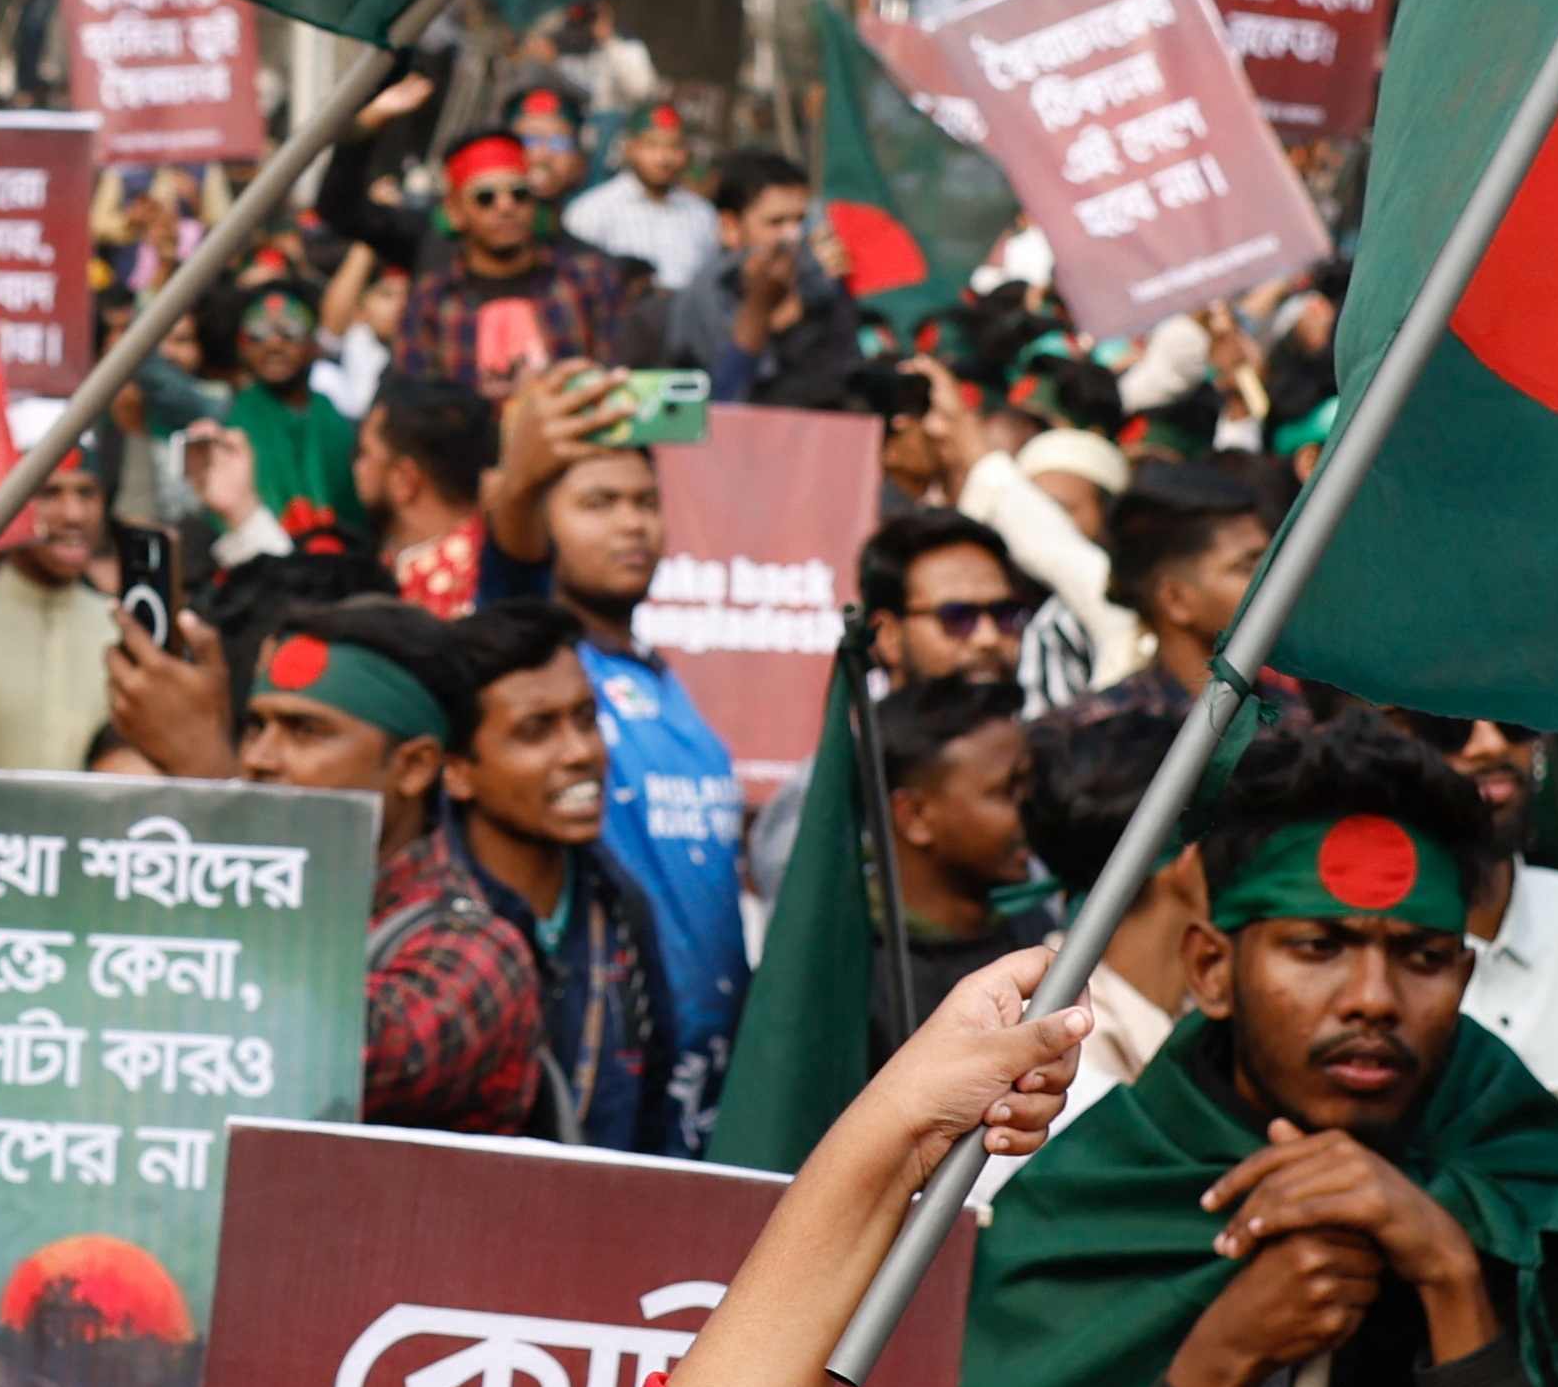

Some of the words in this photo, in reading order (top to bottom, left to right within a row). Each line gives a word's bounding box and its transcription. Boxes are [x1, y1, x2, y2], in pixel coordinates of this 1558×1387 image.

[648, 553, 728, 605] ake
[730, 555, 836, 605] back
[79, 816, 309, 910] শহীদের
[87, 932, 263, 1013] কেনা,
[101, 1027, 276, 1098] কারও
[135, 1125, 216, 1191] না
